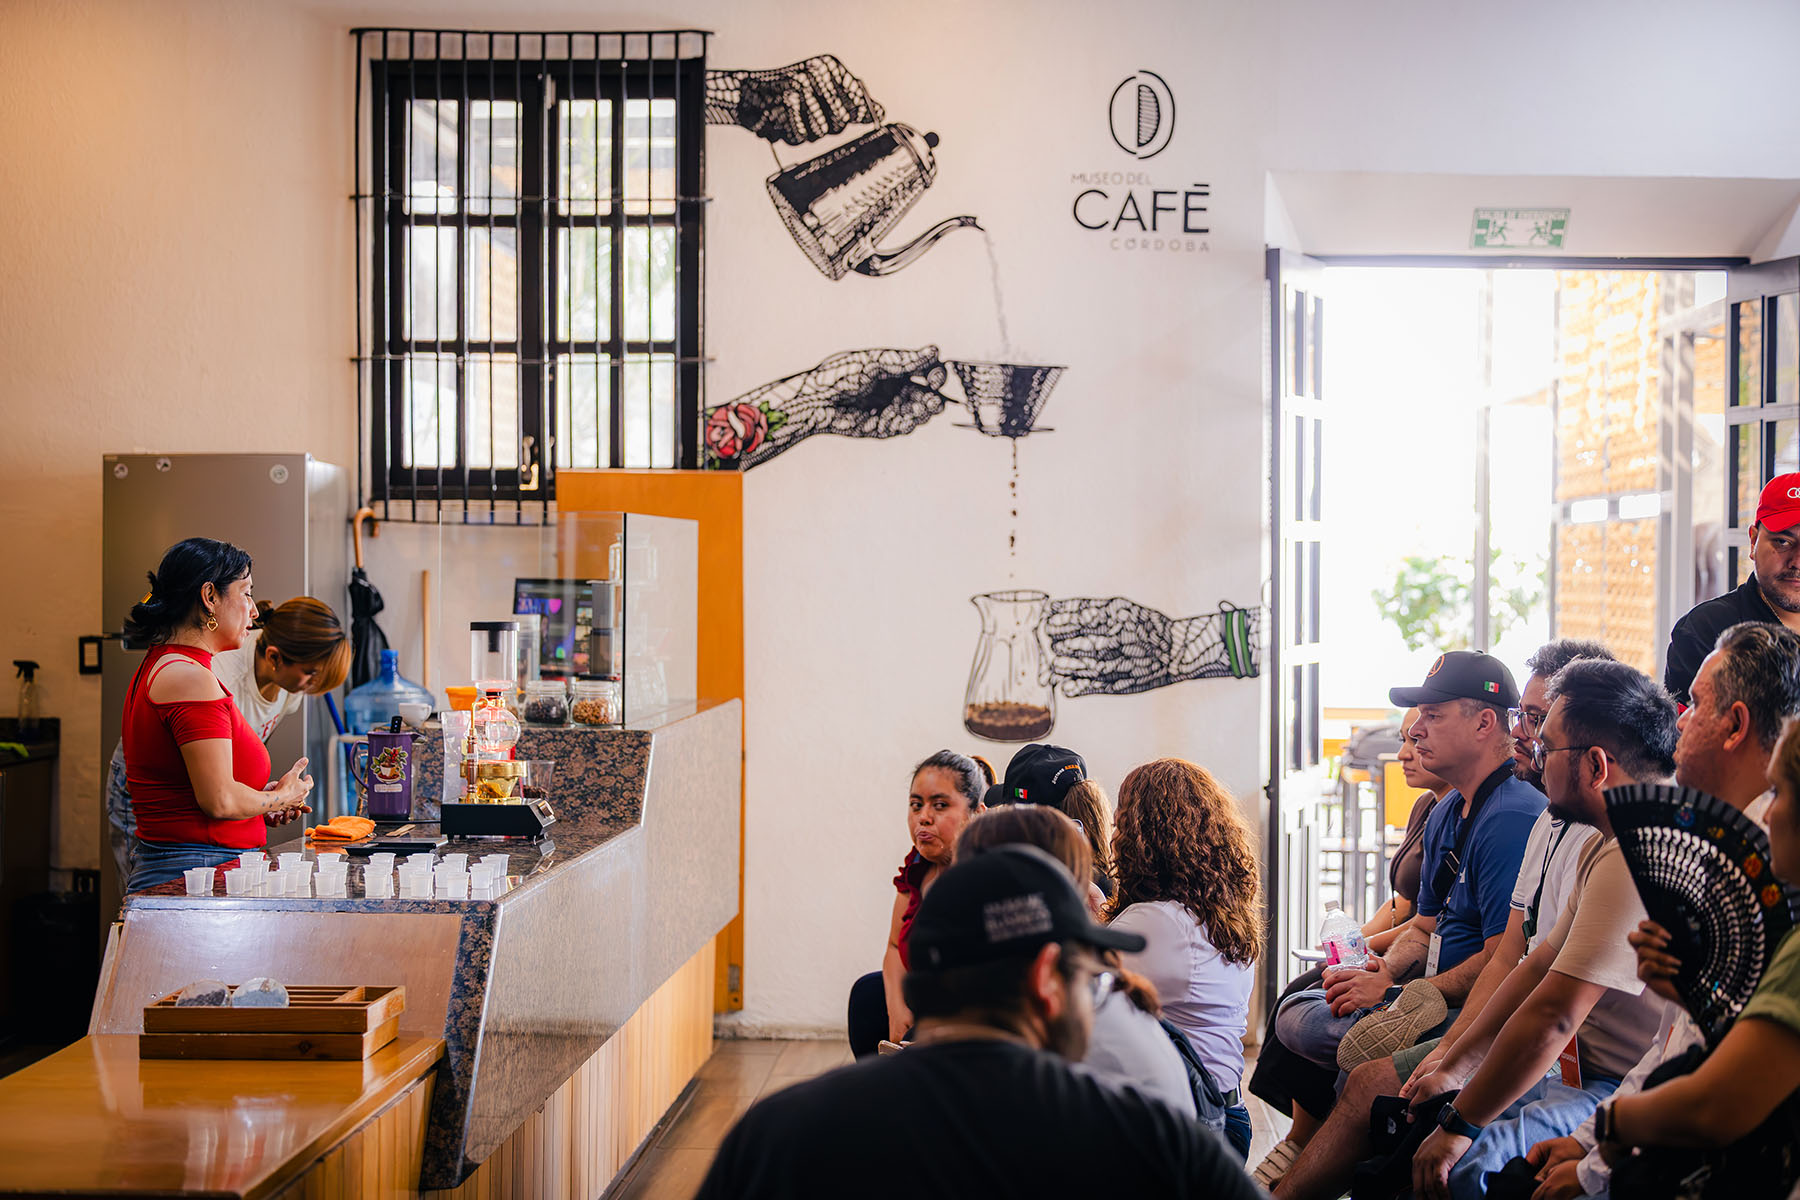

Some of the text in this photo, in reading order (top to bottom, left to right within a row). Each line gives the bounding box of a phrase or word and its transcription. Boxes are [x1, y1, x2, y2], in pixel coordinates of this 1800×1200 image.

[1071, 172, 1152, 185] MUSEO DEL
[1073, 183, 1210, 233] CAFÉ
